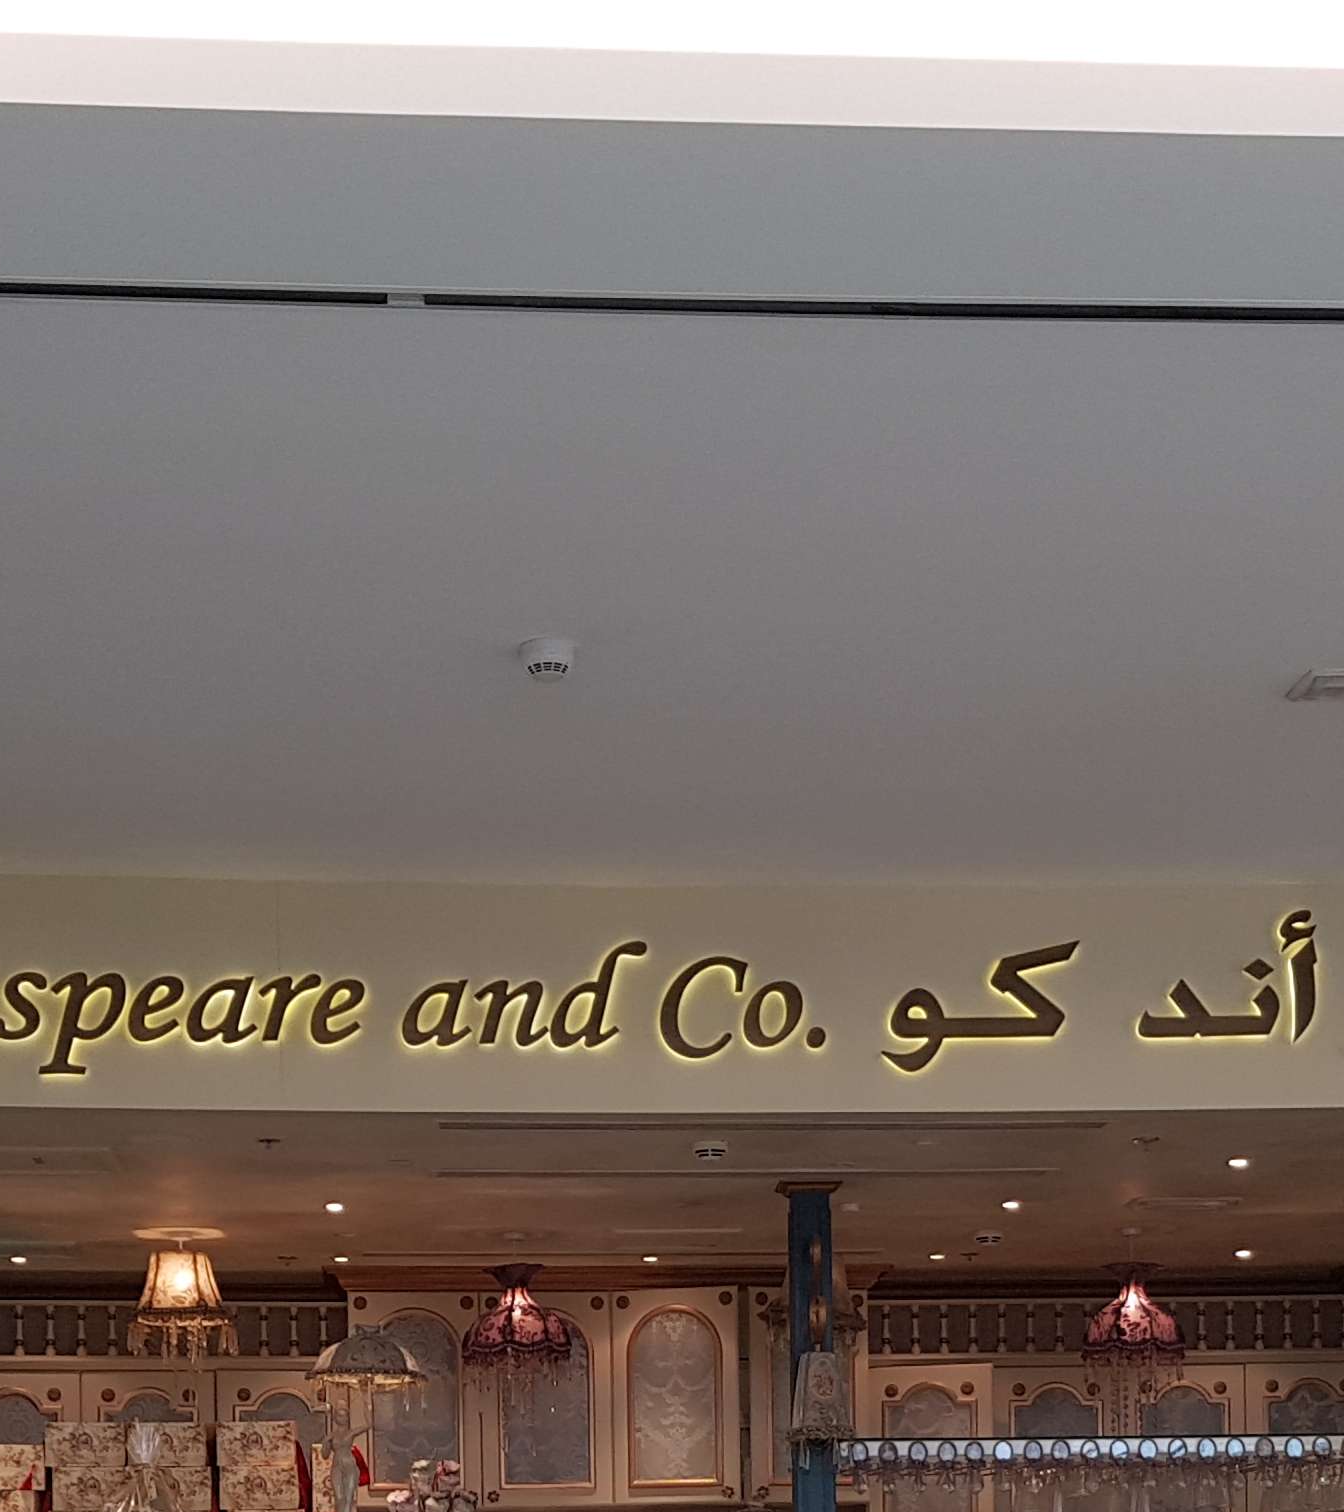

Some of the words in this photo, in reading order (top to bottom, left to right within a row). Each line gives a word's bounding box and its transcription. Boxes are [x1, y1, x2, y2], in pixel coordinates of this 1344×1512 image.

[401, 939, 650, 1049] and
[658, 955, 828, 1061] Co.
[880, 939, 1083, 1073] كو
[1136, 908, 1320, 1042] أند
